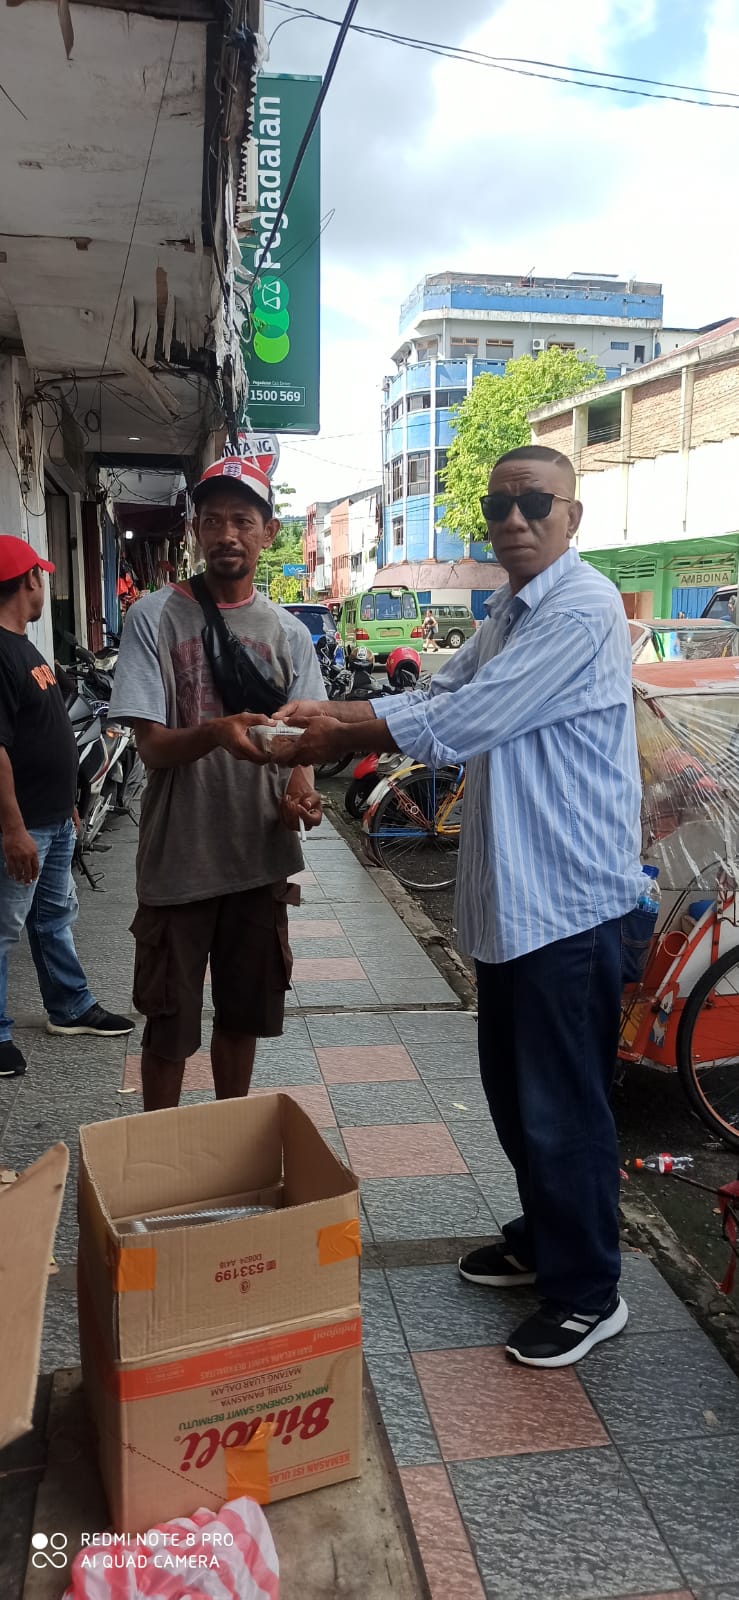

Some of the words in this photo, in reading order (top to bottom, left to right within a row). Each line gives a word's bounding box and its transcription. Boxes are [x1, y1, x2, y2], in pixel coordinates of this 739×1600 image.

[254, 96, 289, 269] Pegadaian
[250, 389, 278, 401] 1500
[280, 391, 301, 402] 569
[680, 572, 730, 585] AMBOINA
[214, 1262, 265, 1283] 533199
[243, 1375, 266, 1389] LUAR
[266, 1367, 302, 1382] MATANG
[210, 1382, 242, 1397] DALAM
[221, 1389, 265, 1407] PANASNYA
[268, 1383, 293, 1396] STABIL
[295, 1384, 329, 1401] MINYAK
[256, 1393, 295, 1412] GORENG
[226, 1403, 256, 1421] SAWIT
[178, 1412, 225, 1431] BERMUTU
[306, 1452, 350, 1473] KEMASAN
